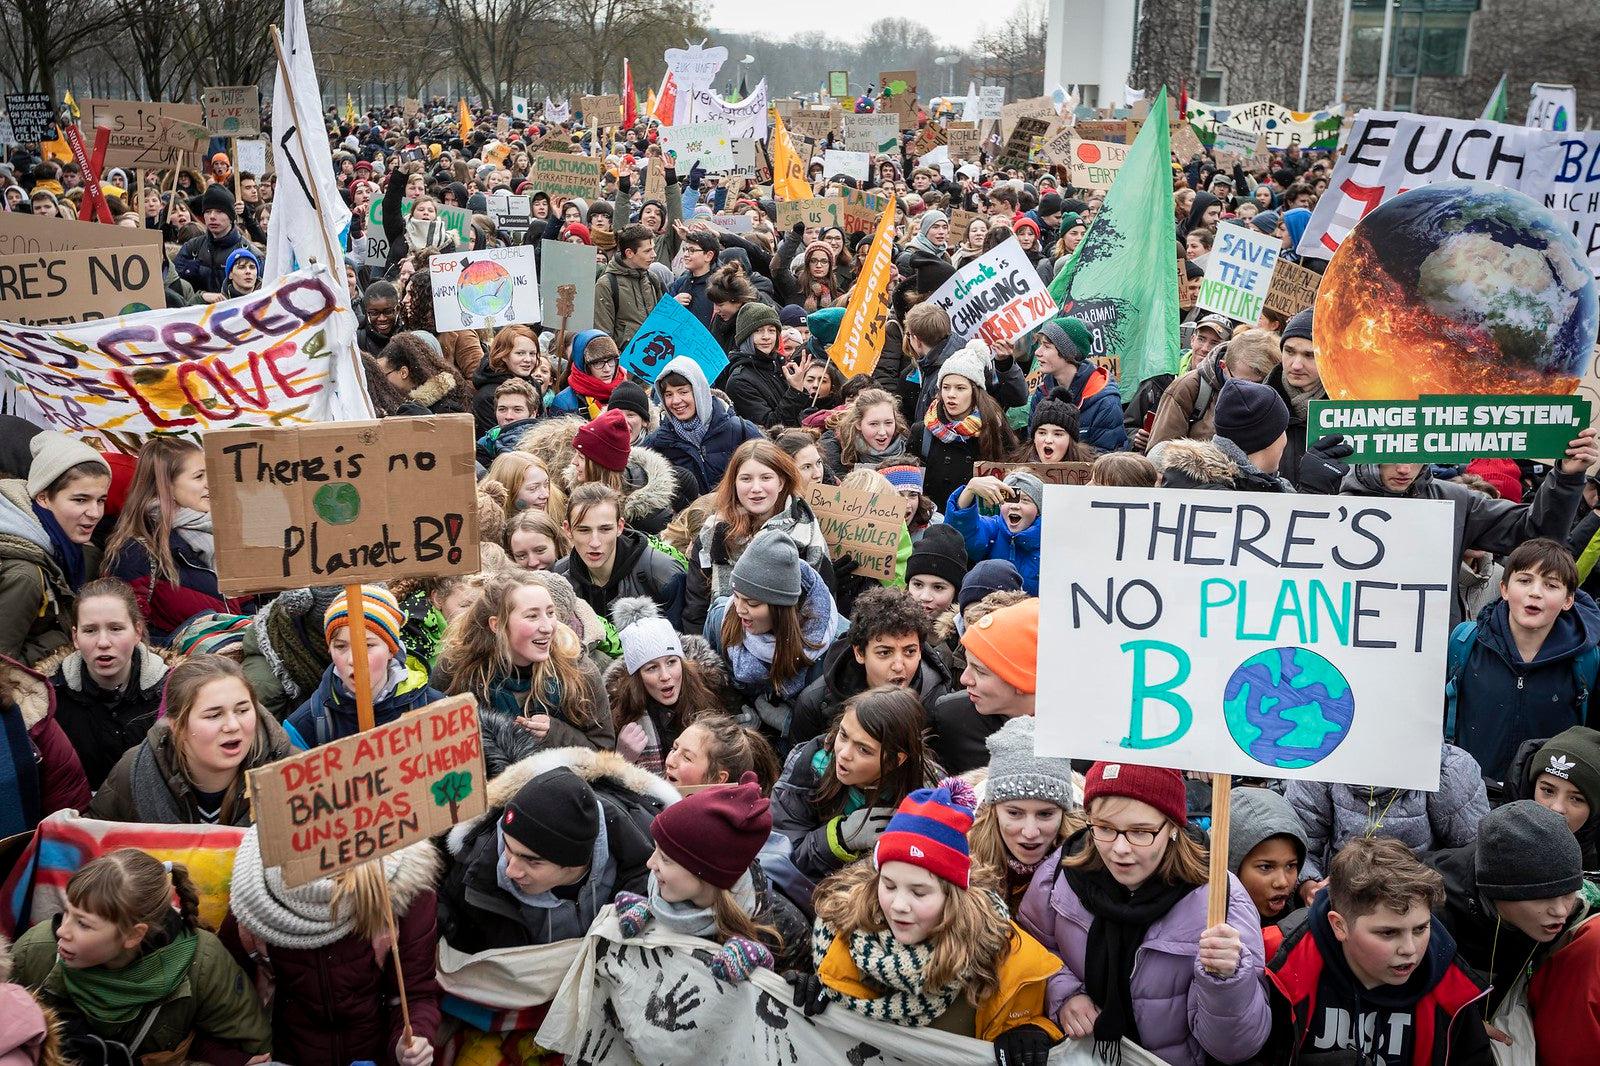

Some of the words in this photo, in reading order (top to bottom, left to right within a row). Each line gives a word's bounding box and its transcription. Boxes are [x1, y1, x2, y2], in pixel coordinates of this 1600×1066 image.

[950, 130, 978, 140] KOHLE
[1232, 103, 1275, 125] THERE
[1278, 112, 1292, 125] IS
[110, 134, 145, 149] nsere
[1348, 118, 1525, 181] EUCH
[537, 156, 599, 175] FEHLSTUNDEN
[580, 177, 597, 187] MAN
[1088, 166, 1119, 184] EART
[809, 212, 822, 223] US
[431, 257, 457, 273] STOP
[489, 247, 525, 260] GLOBAL
[1219, 233, 1277, 269] SAVE
[88, 253, 150, 295] NO
[513, 275, 528, 286] ING
[954, 262, 998, 301] climate
[997, 256, 1010, 271] is
[1219, 260, 1259, 291] THE
[951, 269, 1031, 337] CHANGING
[1022, 290, 1056, 322] YOU
[1198, 278, 1263, 322] NATURE
[98, 277, 337, 367] GREED
[107, 342, 324, 428] LOVE
[1319, 407, 1416, 428] CHANGE
[1421, 406, 1468, 426] THE
[1473, 405, 1580, 427] SYSTEM,
[222, 442, 330, 485] There
[333, 446, 366, 479] is
[388, 449, 436, 473] no
[1319, 434, 1366, 453] OT
[1372, 433, 1418, 453] THE
[1423, 432, 1527, 453] CLIMATE
[810, 489, 832, 507] Bin
[842, 498, 862, 514] ich
[869, 506, 899, 519] noch
[282, 522, 407, 577] Planet
[412, 512, 463, 565] B!
[1090, 501, 1393, 571] THERE'S
[1071, 577, 1164, 631] NO
[1199, 577, 1448, 653] PLANET
[1120, 640, 1194, 750] B
[280, 747, 342, 792] DER
[352, 719, 422, 766] ATEM
[429, 704, 476, 742] DER
[286, 766, 393, 826] BÄUME
[398, 733, 480, 786] SCHENKT
[1545, 766, 1569, 779] adidas
[291, 817, 348, 852] UNS
[352, 791, 412, 830] DAS
[319, 812, 419, 871] LEBEN
[1314, 1007, 1412, 1056] JUST
